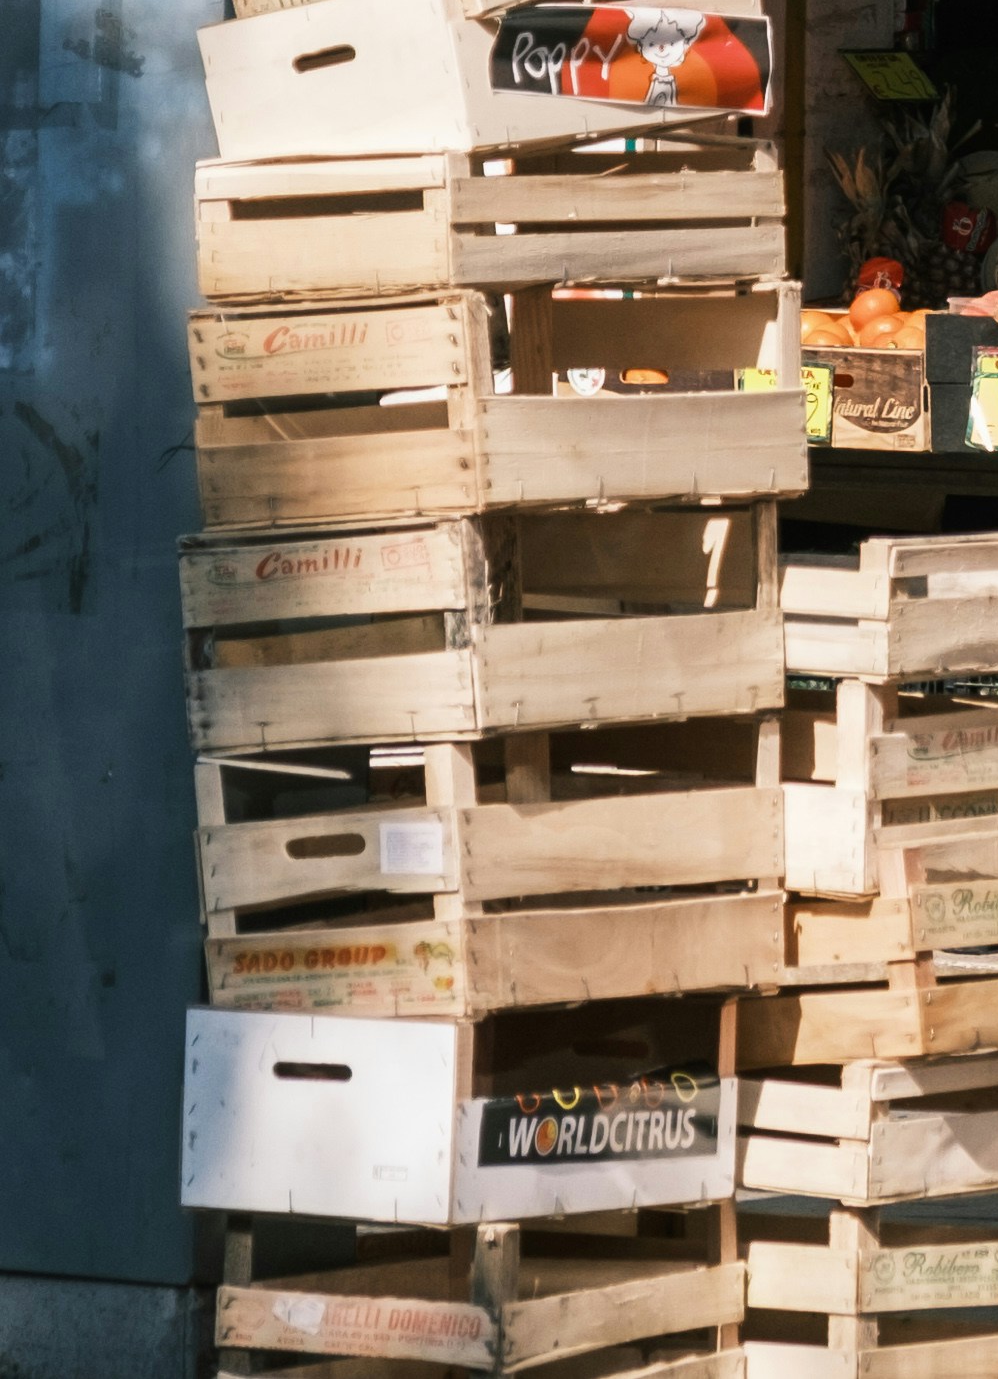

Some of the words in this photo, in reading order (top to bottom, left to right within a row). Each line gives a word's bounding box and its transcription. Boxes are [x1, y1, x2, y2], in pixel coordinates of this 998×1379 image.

[263, 323, 369, 355] Camilli
[882, 398, 915, 420] Line
[256, 548, 363, 580] Camilli
[233, 950, 295, 974] SADO
[304, 944, 387, 970] GROUP
[509, 1107, 697, 1158] WORLDCITRUS
[387, 1307, 483, 1342] DOMENICO
